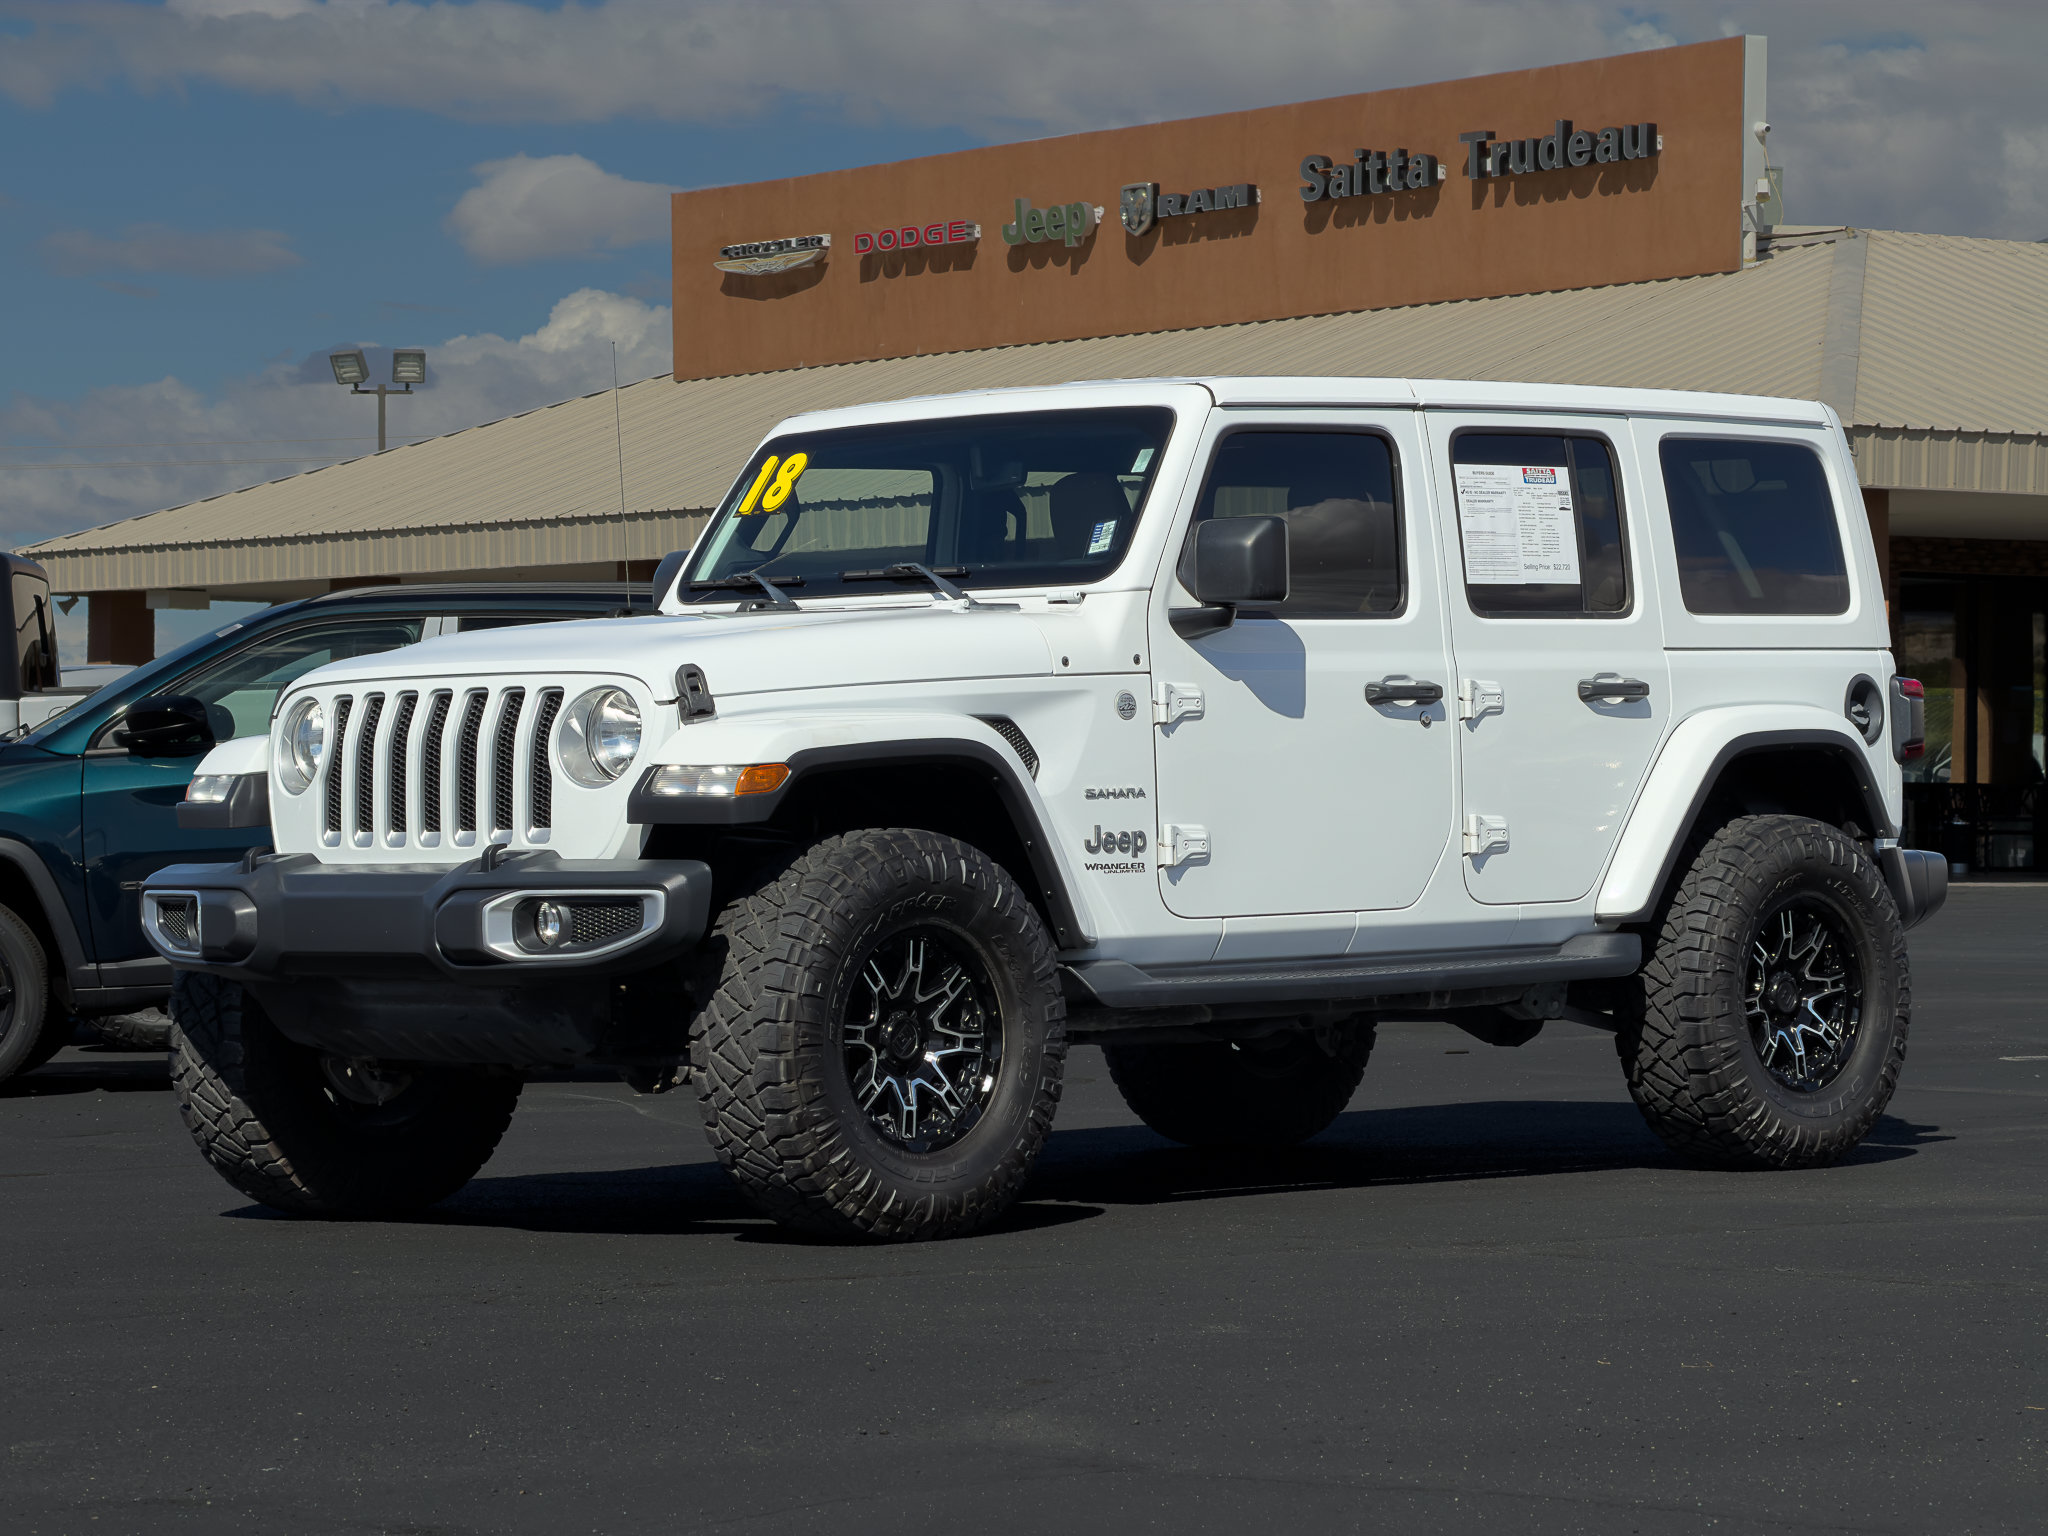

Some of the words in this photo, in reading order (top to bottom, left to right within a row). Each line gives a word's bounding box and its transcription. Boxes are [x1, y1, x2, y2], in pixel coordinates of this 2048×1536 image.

[1300, 148, 1436, 202] Saitta
[1459, 119, 1655, 181] Trudeau
[1157, 184, 1252, 218] RAM
[854, 220, 972, 255] DODGE
[1002, 198, 1091, 247] Jeep
[719, 235, 824, 258] CHRYSLER
[738, 452, 809, 515] 18
[1523, 563, 1538, 571] Selling
[1084, 787, 1147, 800] SAHARA
[1084, 825, 1147, 858] Jeep
[1084, 862, 1145, 871] WRANGLER
